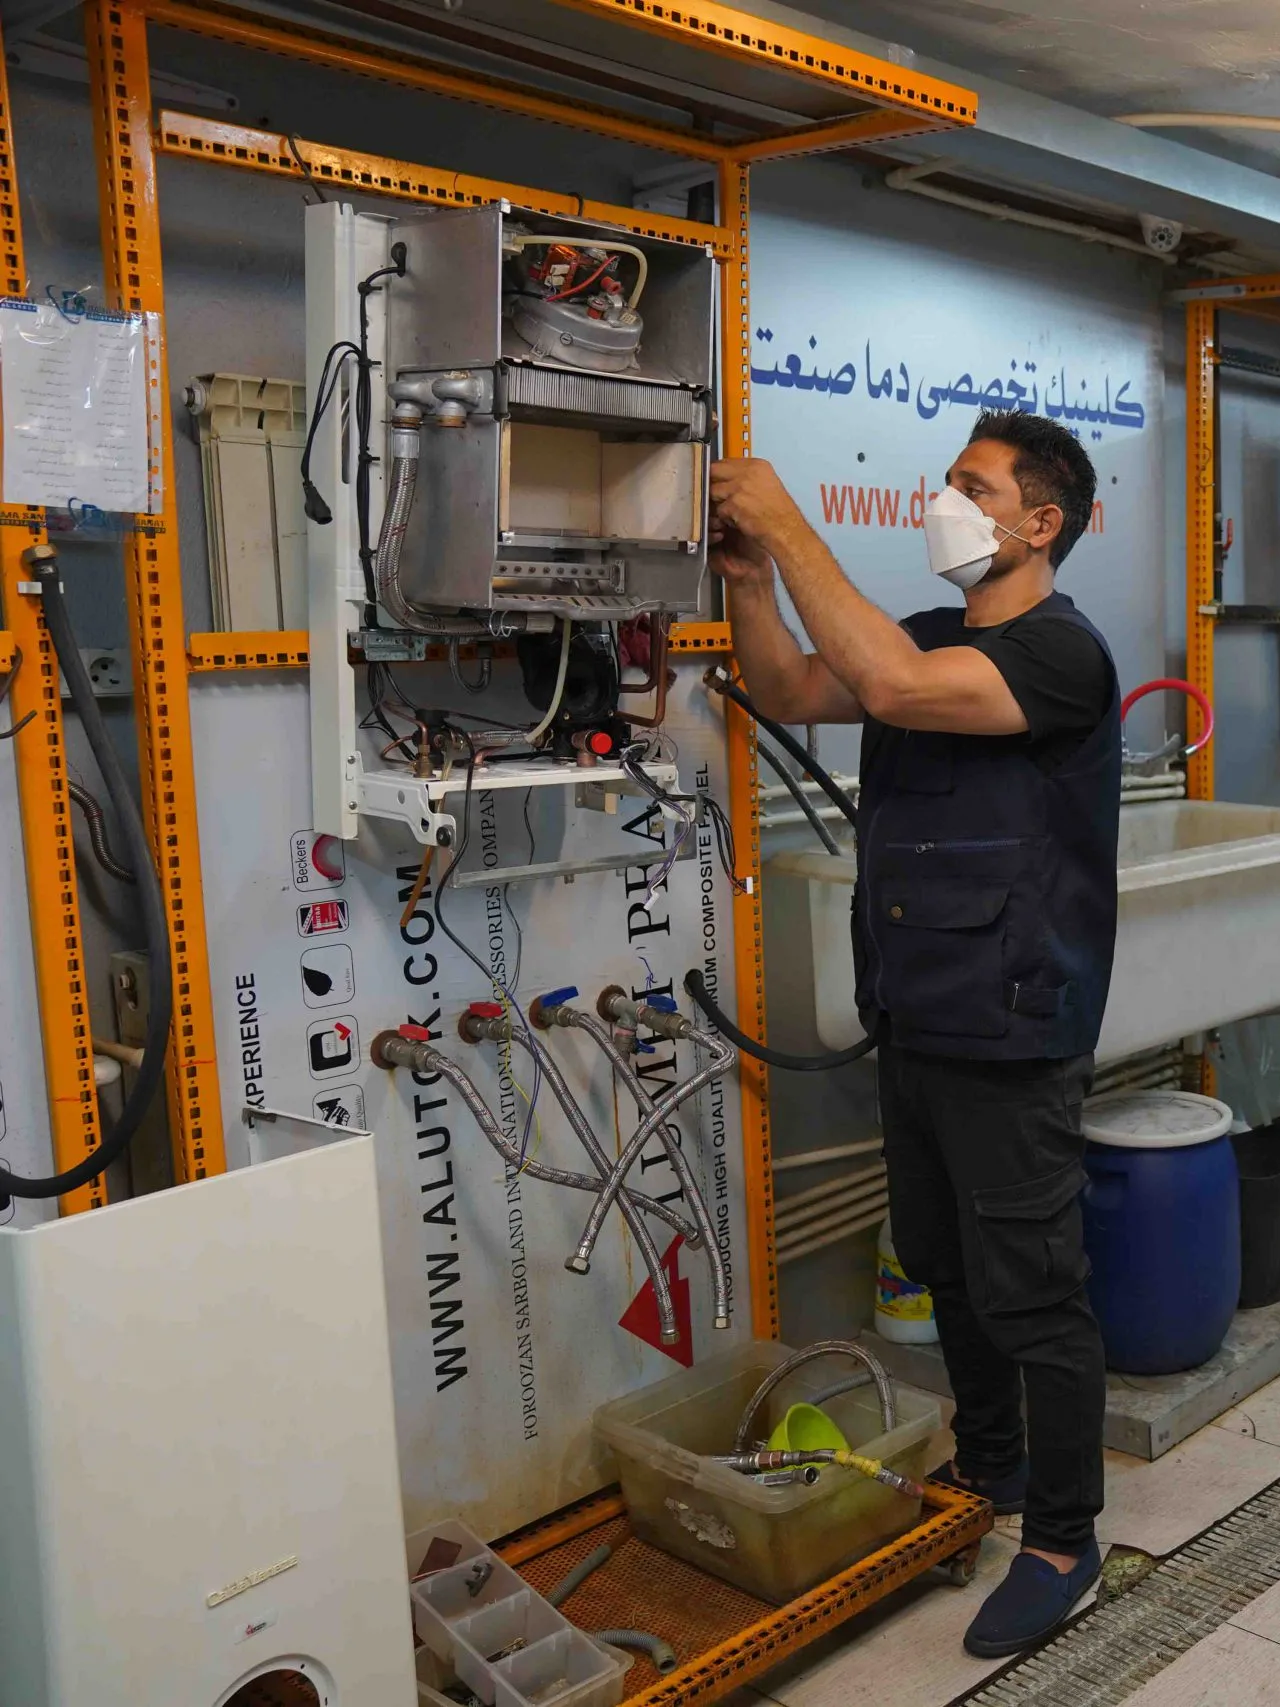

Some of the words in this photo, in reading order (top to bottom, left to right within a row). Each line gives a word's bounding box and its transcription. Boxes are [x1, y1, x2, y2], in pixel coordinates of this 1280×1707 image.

[866, 337, 910, 403] دما
[295, 839, 309, 884] Beckers
[698, 835, 716, 952] COMPOSITE
[710, 1080, 726, 1147] QUALIT
[714, 1153, 728, 1200] HIGH
[509, 1209, 532, 1329] SARBOLAND
[517, 1334, 538, 1440] FOROOZAN
